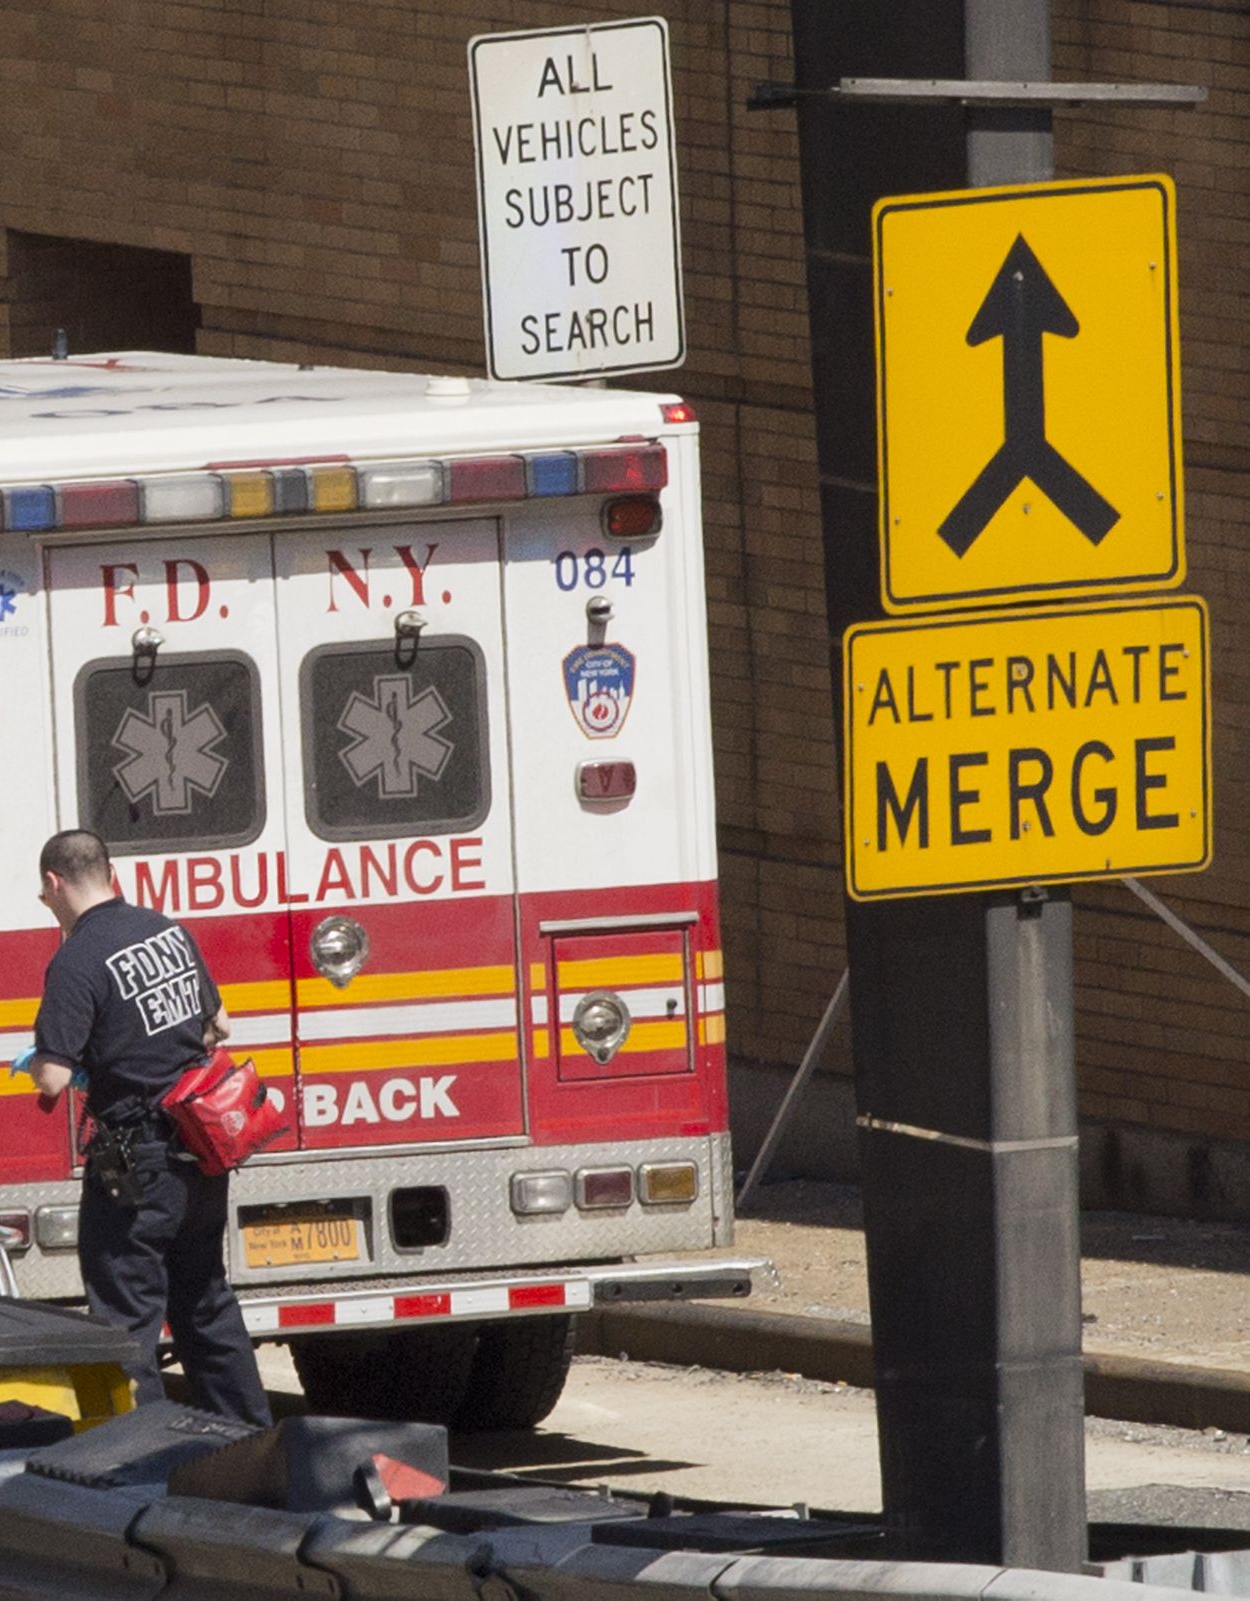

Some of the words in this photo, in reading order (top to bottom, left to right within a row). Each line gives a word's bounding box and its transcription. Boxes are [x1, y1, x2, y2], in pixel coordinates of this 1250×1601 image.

[537, 52, 613, 98] ALL
[492, 110, 658, 165] VEHICLES
[505, 174, 654, 229] SUBJECT
[561, 243, 609, 287] TO
[521, 301, 655, 355] SEARCH
[100, 559, 229, 626] F.D.
[326, 543, 452, 613] N.Y.
[554, 547, 636, 592] 084
[868, 642, 1188, 726] ALTERNATE
[875, 736, 1180, 852] MERGE
[106, 926, 197, 1001] FDNY
[135, 969, 202, 1037] EMT
[303, 1074, 460, 1128] BACK
